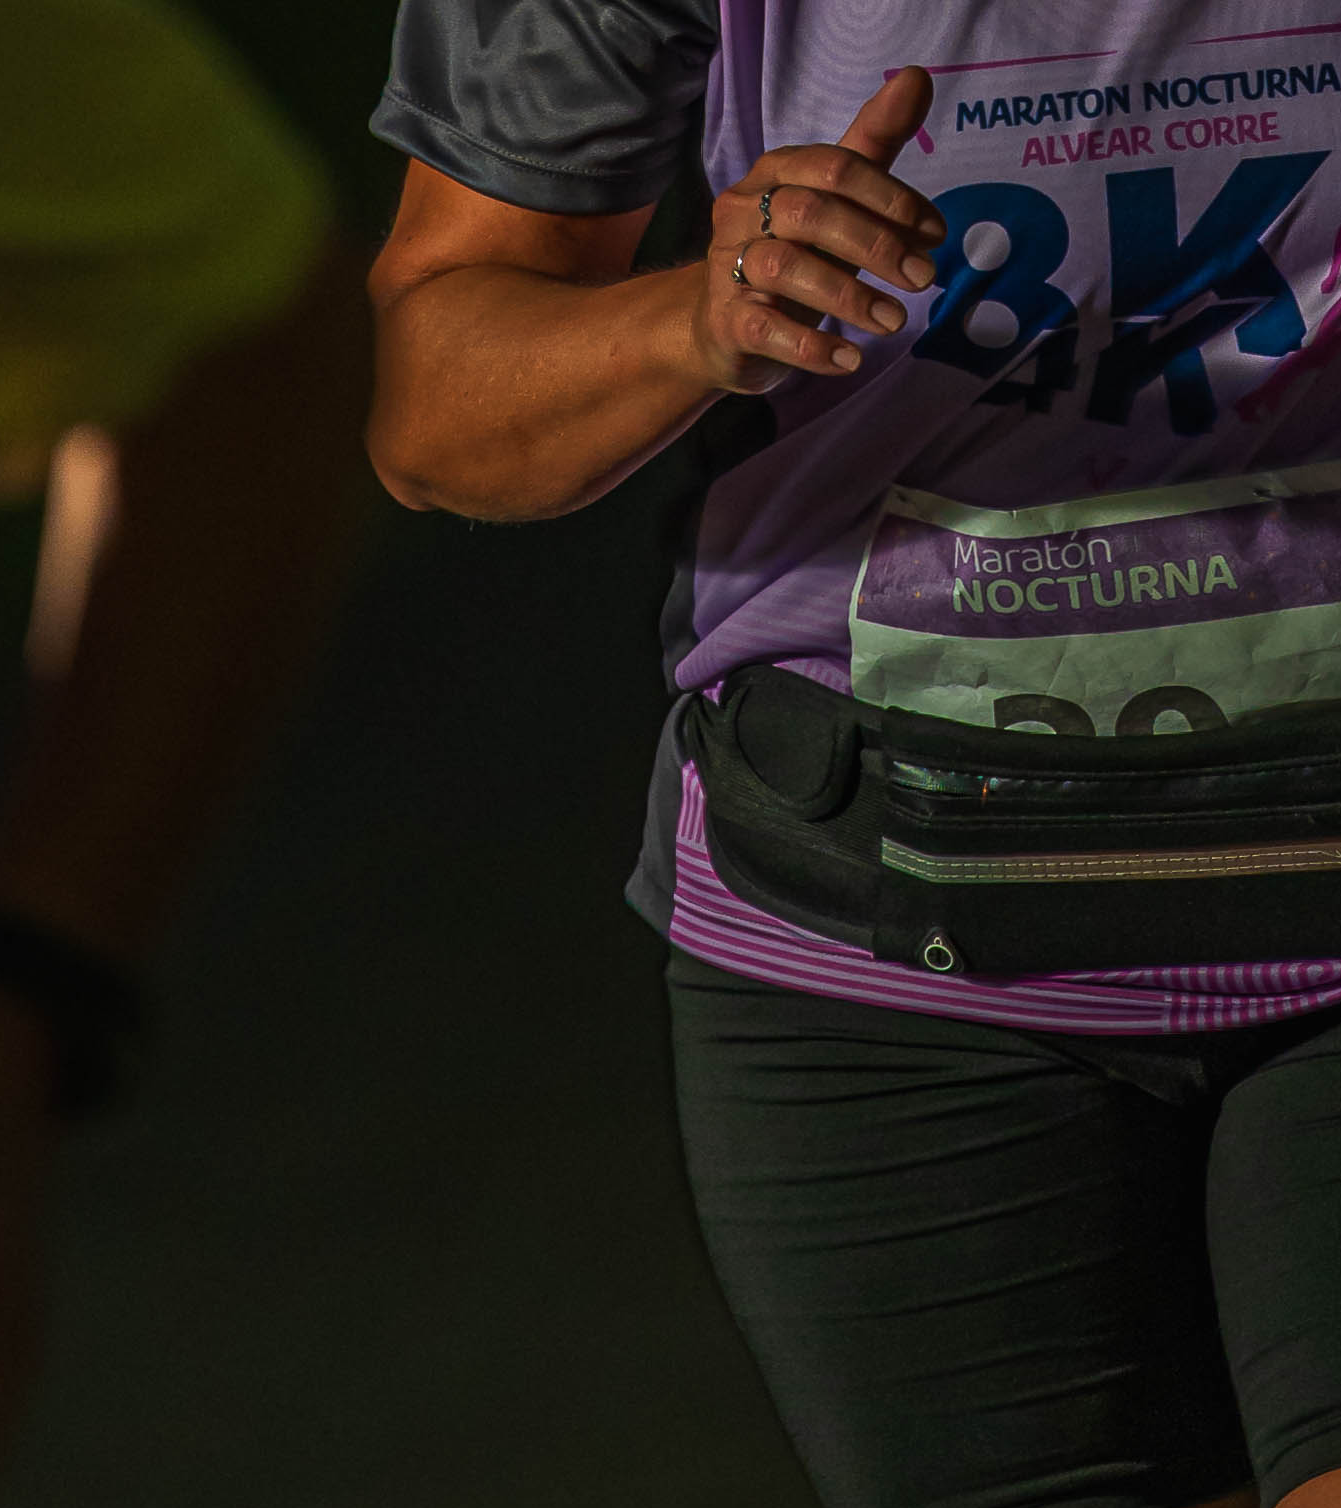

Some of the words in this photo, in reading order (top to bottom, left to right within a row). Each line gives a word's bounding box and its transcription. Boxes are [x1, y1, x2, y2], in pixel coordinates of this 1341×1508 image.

[956, 83, 1131, 132] MARATON
[1021, 124, 1153, 168] ALVEAR
[1163, 111, 1281, 152] CORRE
[912, 150, 1332, 378] 8K
[954, 531, 1112, 572] Maratón
[952, 554, 1238, 616] NOCTURNA
